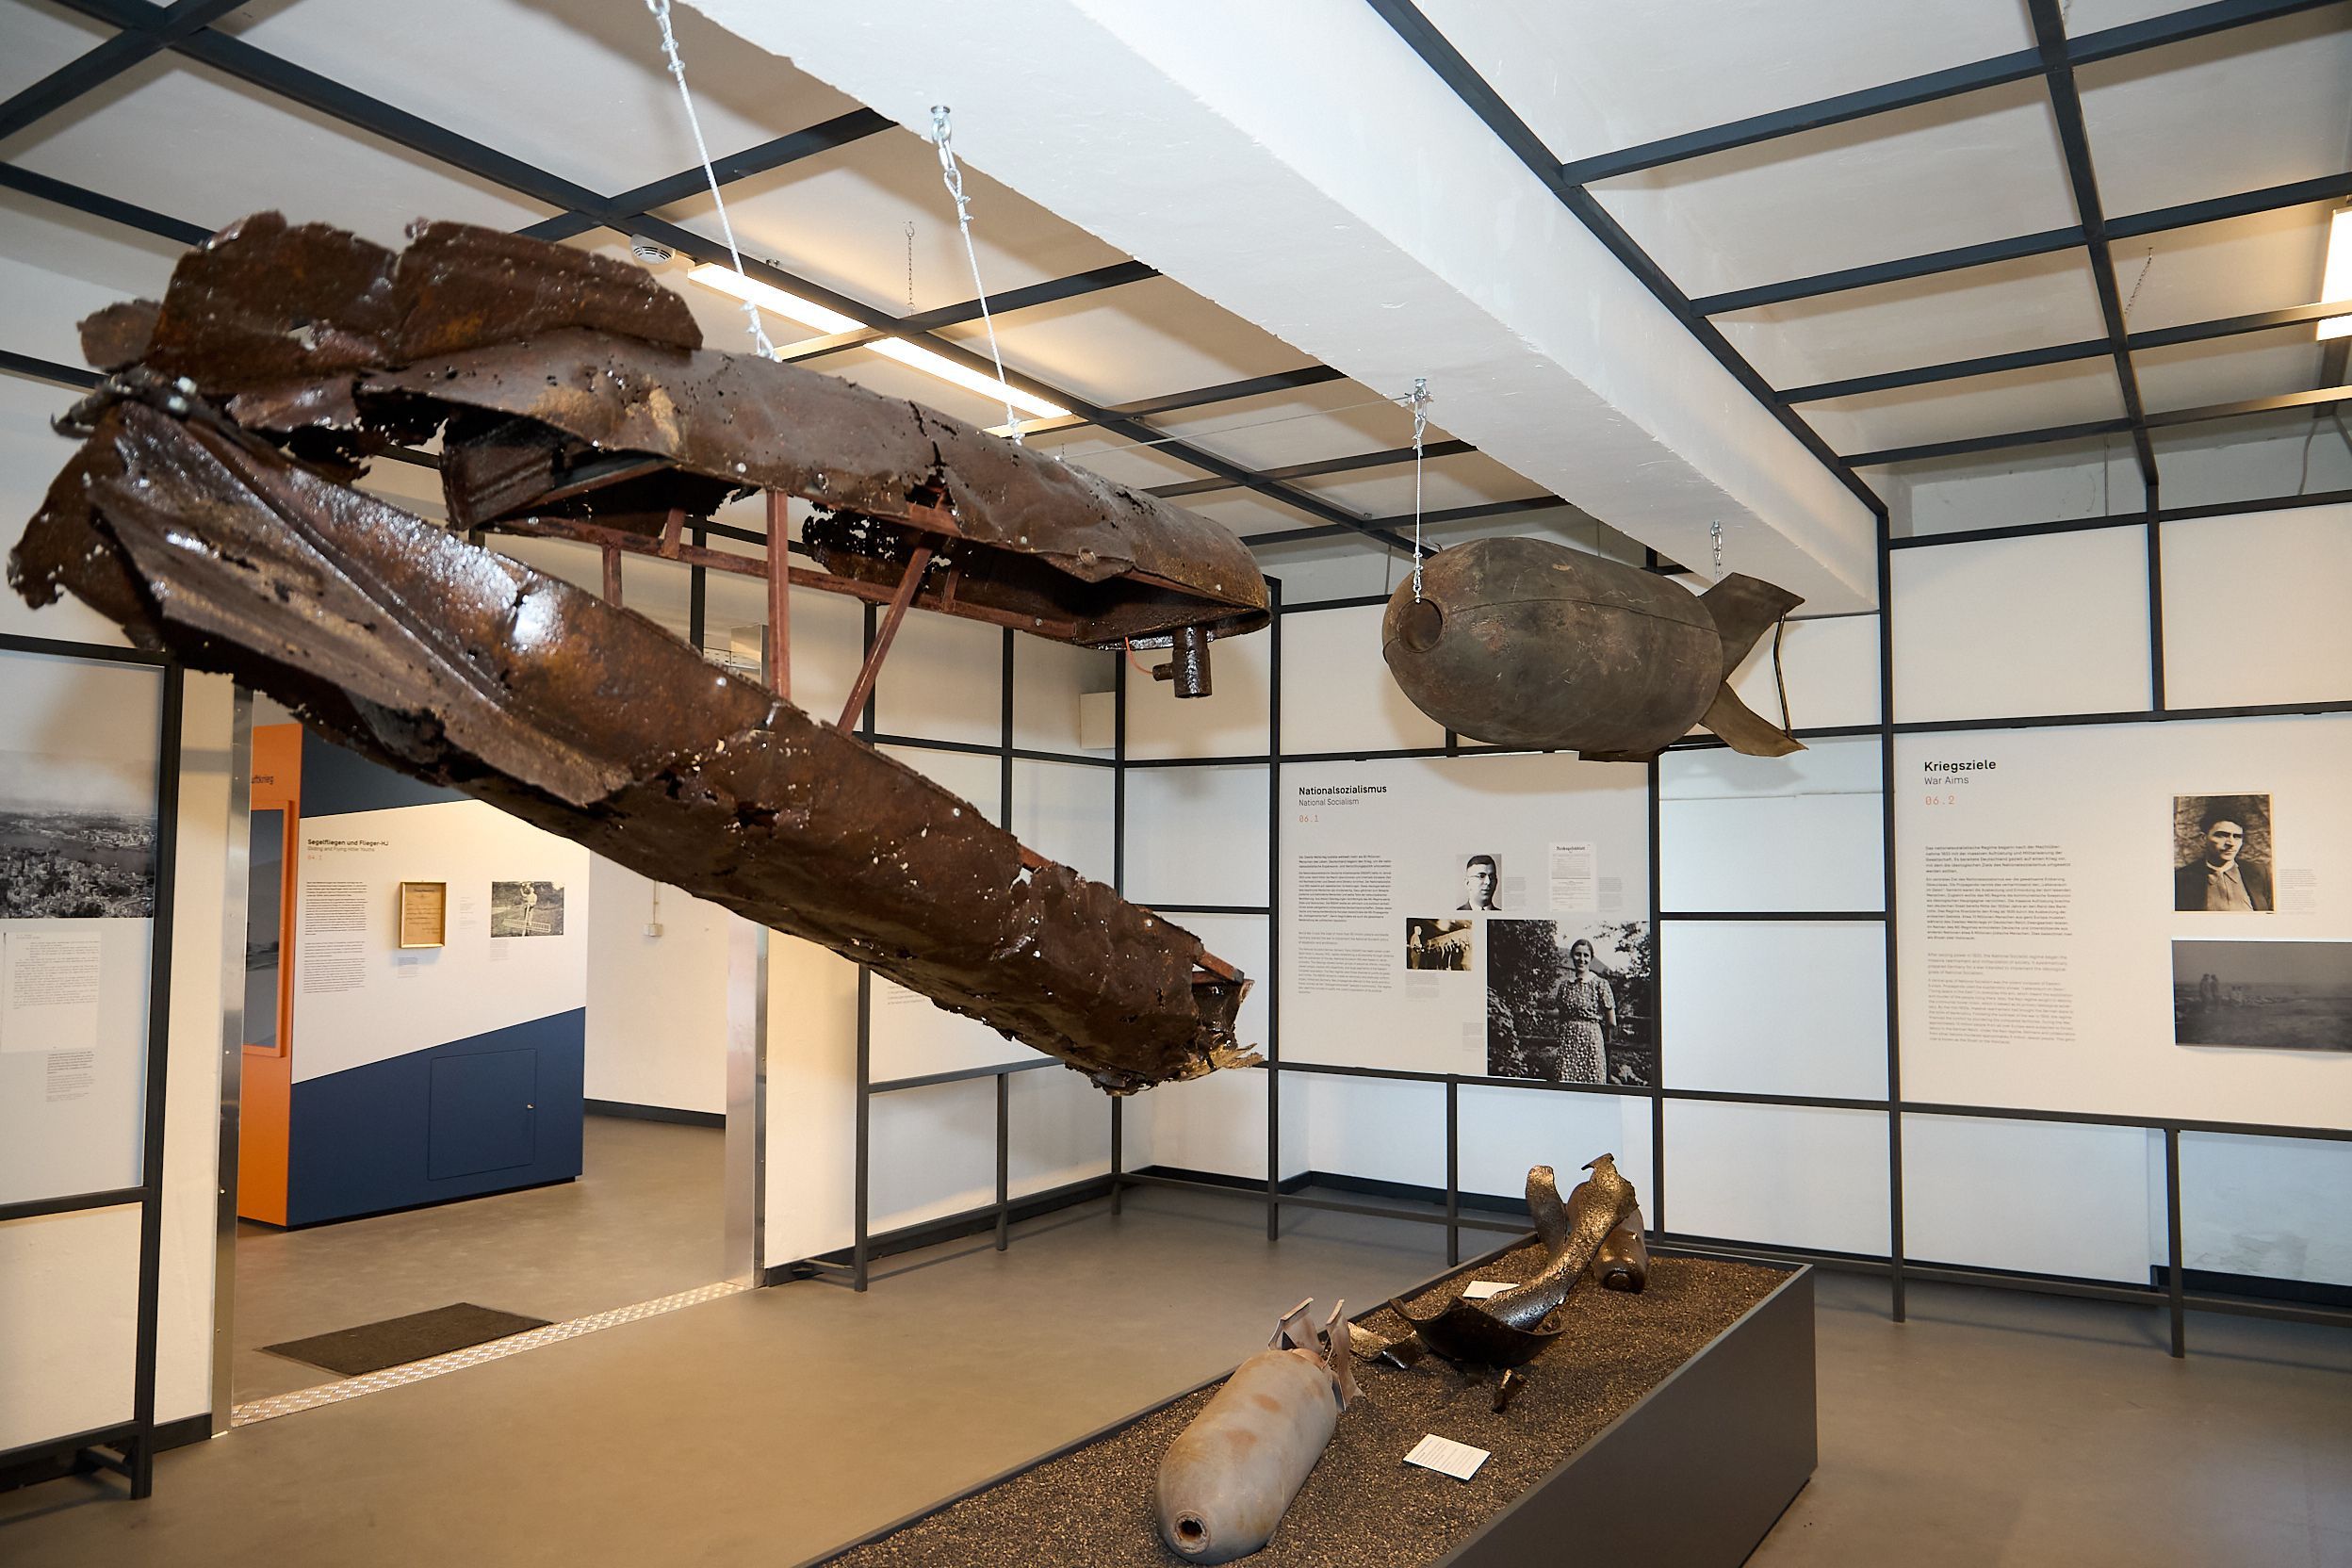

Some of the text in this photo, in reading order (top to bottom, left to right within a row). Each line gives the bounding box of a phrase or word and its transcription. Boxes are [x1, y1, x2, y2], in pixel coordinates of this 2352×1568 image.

[1924, 760, 1996, 773] Kriegsziele
[1924, 776, 1969, 785] War Aims
[1298, 785, 1387, 795] Nationalsozialismus
[1327, 797, 1360, 806] Socialism
[1925, 795, 1954, 805] 06.2
[1298, 814, 1319, 823] 06.1
